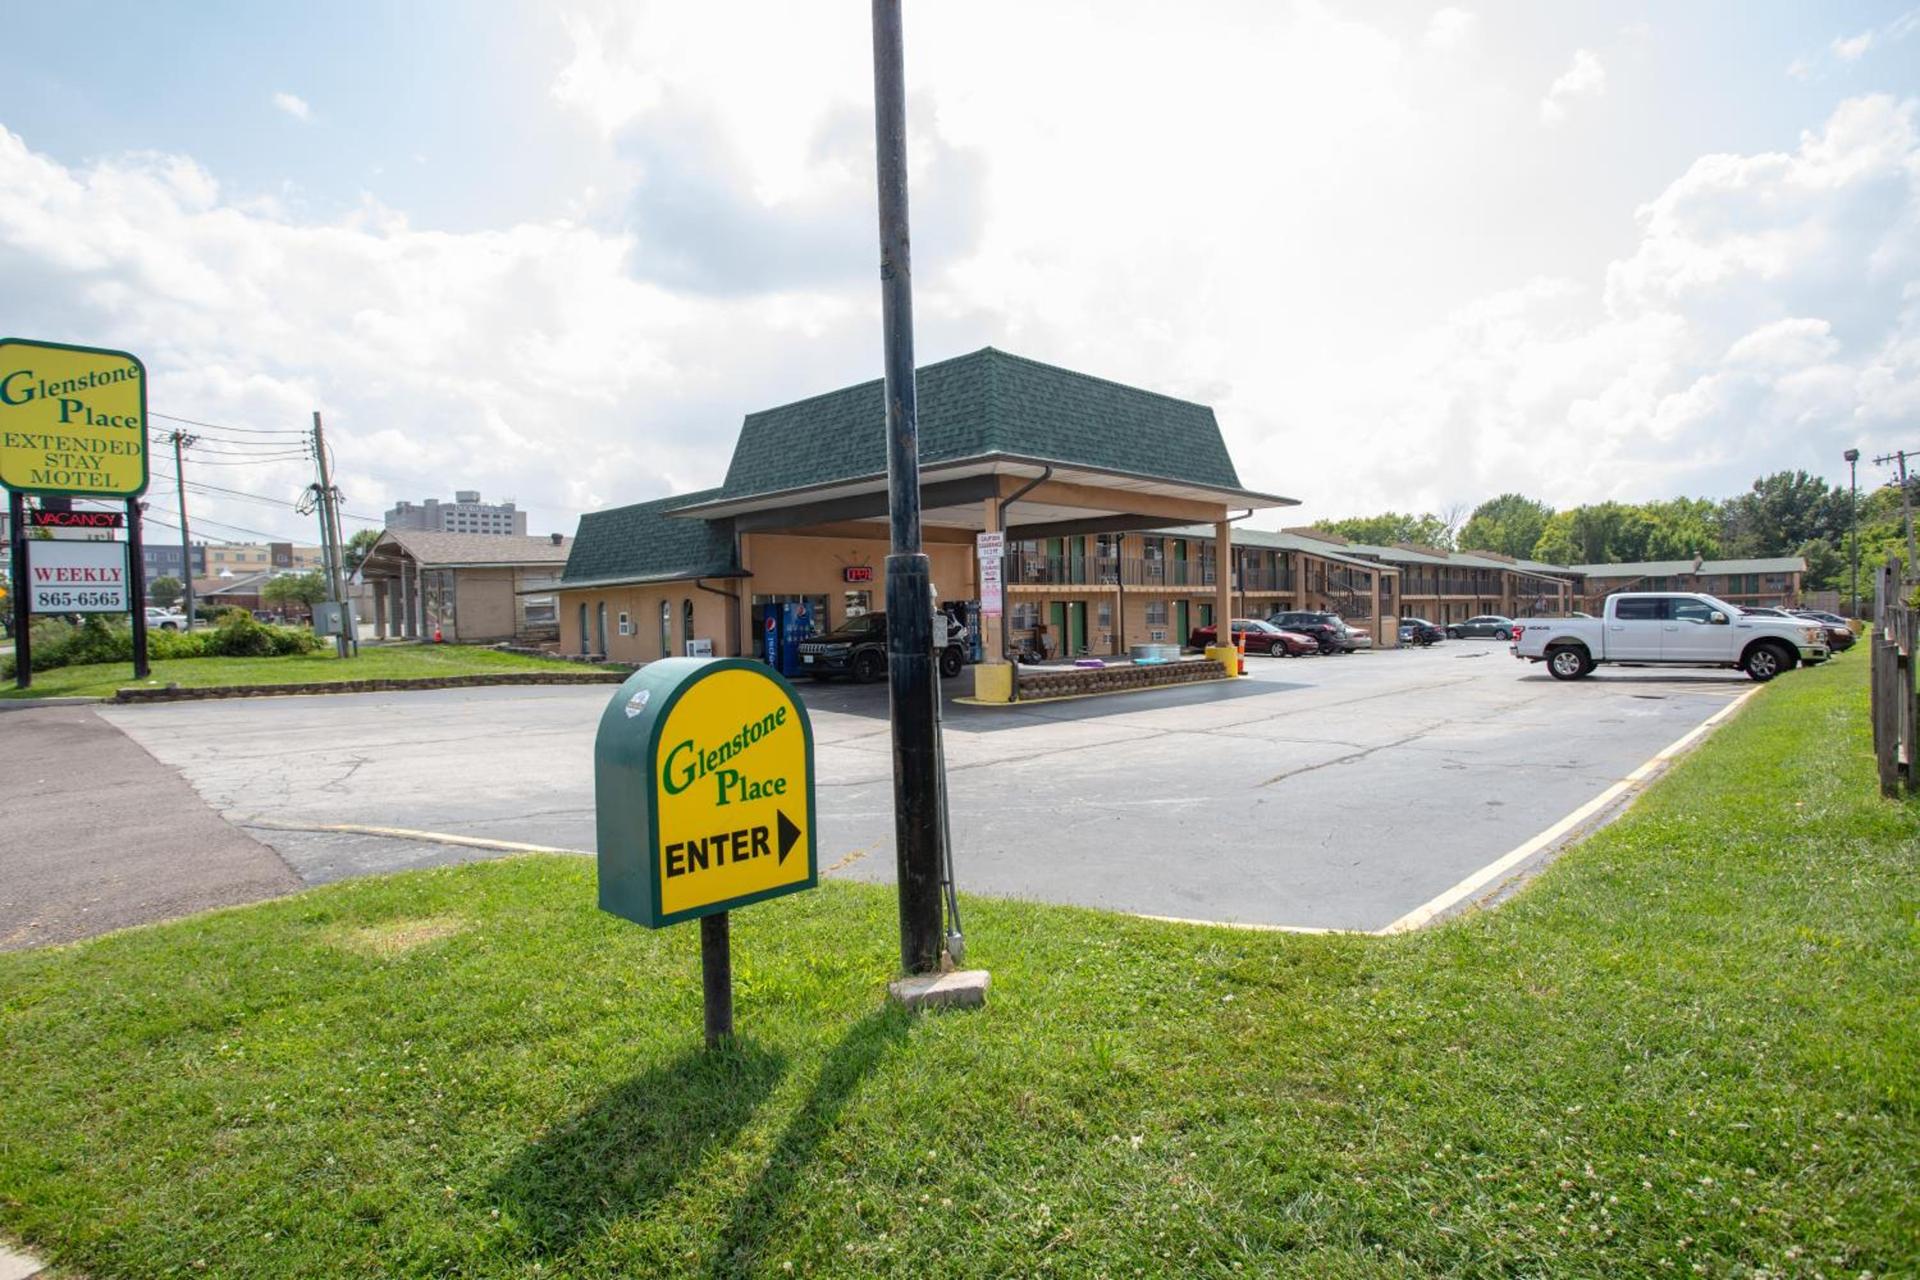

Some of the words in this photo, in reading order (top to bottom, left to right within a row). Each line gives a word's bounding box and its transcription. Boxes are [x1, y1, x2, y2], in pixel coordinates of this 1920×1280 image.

[0, 364, 139, 406] Glenstone
[58, 398, 138, 429] Place
[4, 432, 140, 456] EXTENDED
[45, 453, 104, 470] STAY
[30, 469, 119, 488] MOTEL
[34, 512, 116, 526] VACANCY
[34, 567, 122, 582] WEEKLY
[39, 592, 120, 606] 865-6565
[663, 706, 786, 795] Glenstone
[716, 768, 786, 806] Place
[665, 826, 770, 878] ENTER
